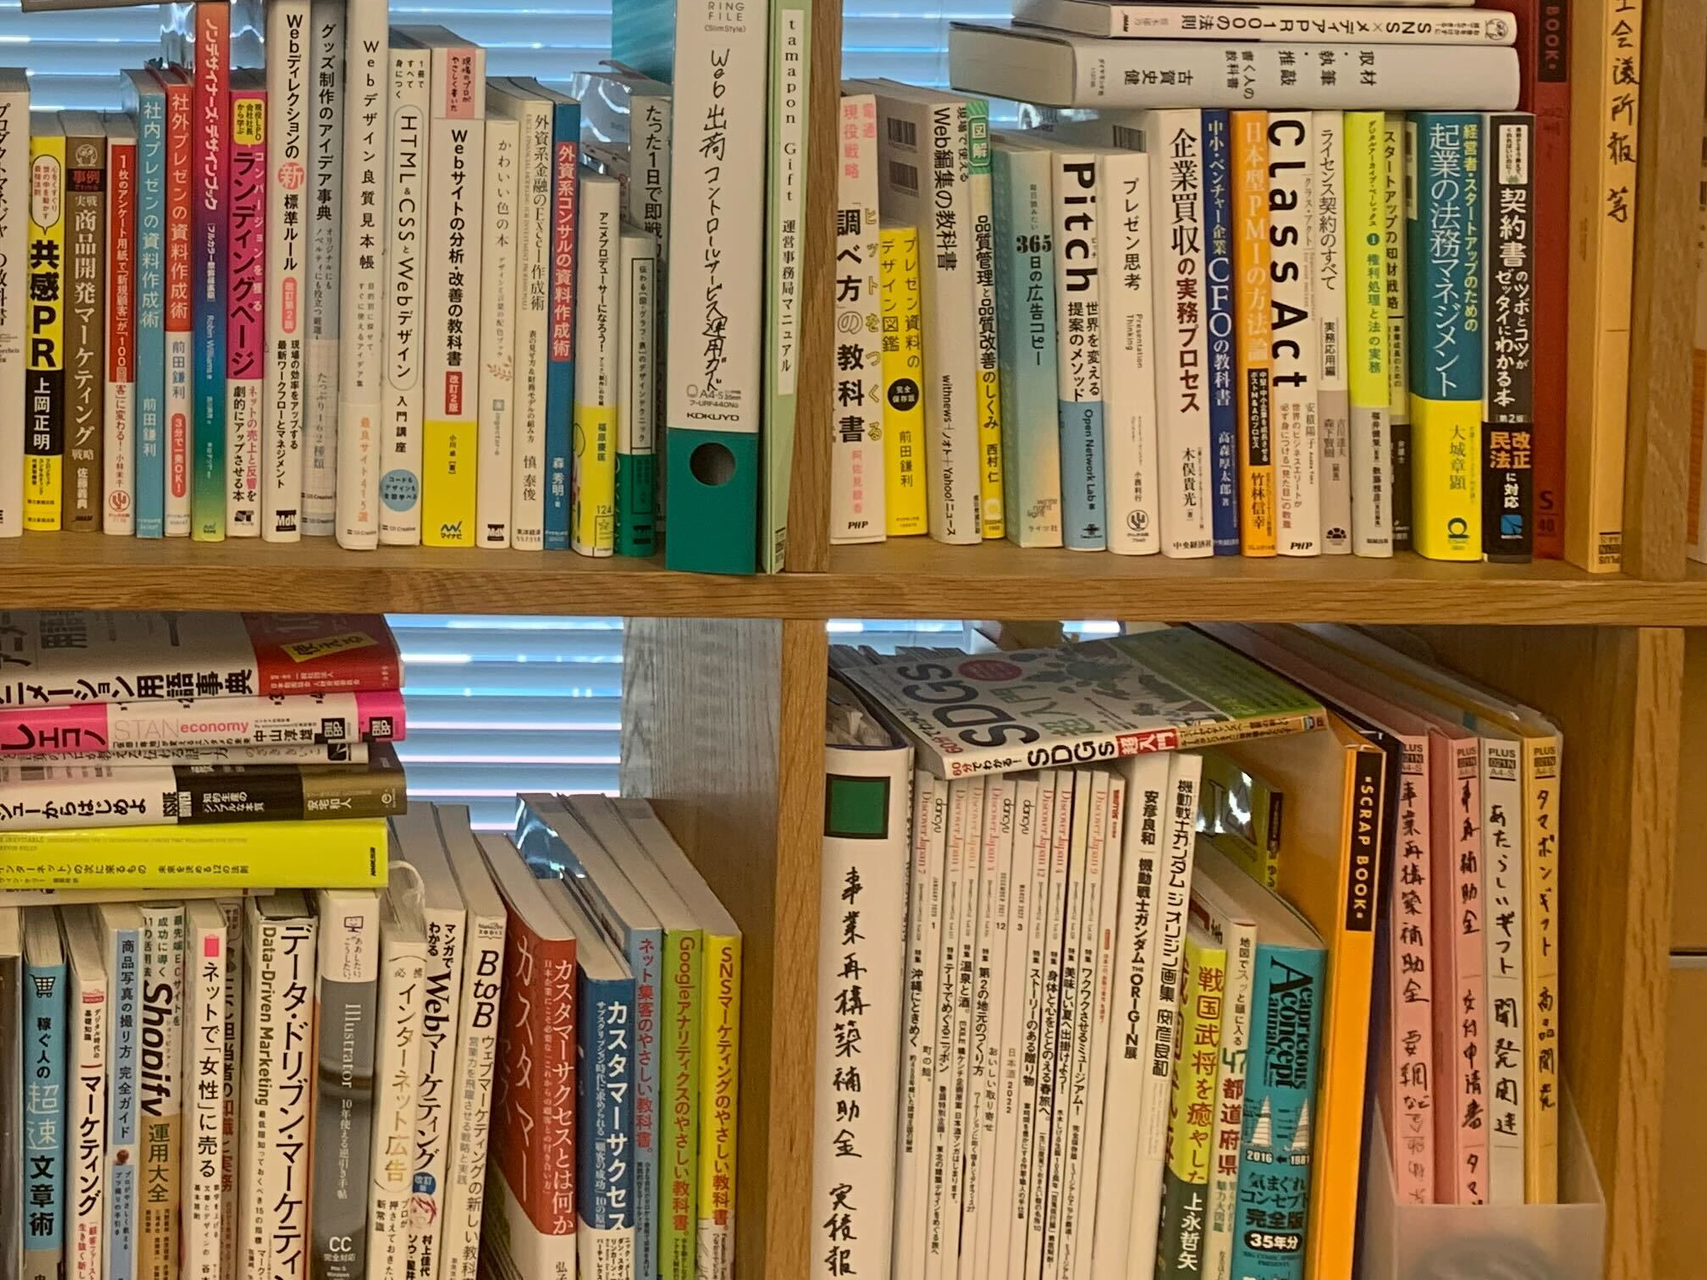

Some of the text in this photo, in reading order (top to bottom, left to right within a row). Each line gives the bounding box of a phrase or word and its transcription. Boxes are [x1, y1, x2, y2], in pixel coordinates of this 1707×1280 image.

[316, 24, 336, 221] グッズ制作のアイデア事典
[1125, 68, 1193, 86] 古賀史健
[1545, 8, 1559, 62] BOOK
[142, 102, 161, 329] 社内プレゼンの資料作成術
[171, 93, 189, 319] 社外プレゼンの資料作成術
[359, 40, 380, 270] Webデザイン良質見本帳
[446, 129, 468, 367] Webサイトの分析・改善の教科書
[495, 139, 512, 248] かわいい色の本
[781, 20, 798, 372] tamapon Gift 運営事務局マニュアル
[933, 108, 957, 270] Web編集の教科書
[1063, 162, 1097, 292] Pitch
[1123, 178, 1141, 290] プレゼン思考
[1244, 121, 1270, 361] 日本型PMIの方法論
[1319, 128, 1337, 290] ライセンス契約のすべて
[1499, 188, 1527, 268] 契約書
[29, 242, 60, 368] 共感PR
[74, 210, 97, 445] 商品開発マーケティング
[231, 151, 257, 378] ランディングページ
[552, 144, 576, 358] 外資系コンサルの資料作成術
[597, 213, 609, 353] アニメプロデューサーになろう!
[975, 215, 999, 429] 品質管理と品質改善のしくみ
[1169, 127, 1200, 413] 企業買収の実務プロセス
[1429, 123, 1462, 398] 起業の法務マネジメント
[32, 377, 50, 450] 上岡正明
[687, 411, 739, 421] KOKUYO
[180, 720, 250, 734] economy
[1027, 741, 1117, 767] SDGs
[1141, 790, 1159, 846] 安彦良和
[1354, 784, 1372, 909] SCRAP BOOK
[141, 981, 173, 1117] Shopify
[197, 962, 221, 1178] ネットで「女性」に売る
[255, 927, 277, 1106] Data-Driven Marketing
[341, 1003, 362, 1089] Illustrator
[415, 973, 452, 1171] Webマーケティング
[551, 960, 575, 1235] カスタマーサクセスとは何か
[635, 938, 654, 1153] ネット集客のやさしい教科書。
[672, 937, 695, 1236] Googleアナリティクスのやさしい教科書。
[711, 946, 734, 1231] SNSマーケティングのやさしい教科書。
[833, 867, 870, 1161] 事業再構築補助金
[26, 1017, 60, 1236] 稼ぐ人の超速文章術
[1245, 1207, 1304, 1230] 完全版
[1248, 1234, 1300, 1249] 35年分
